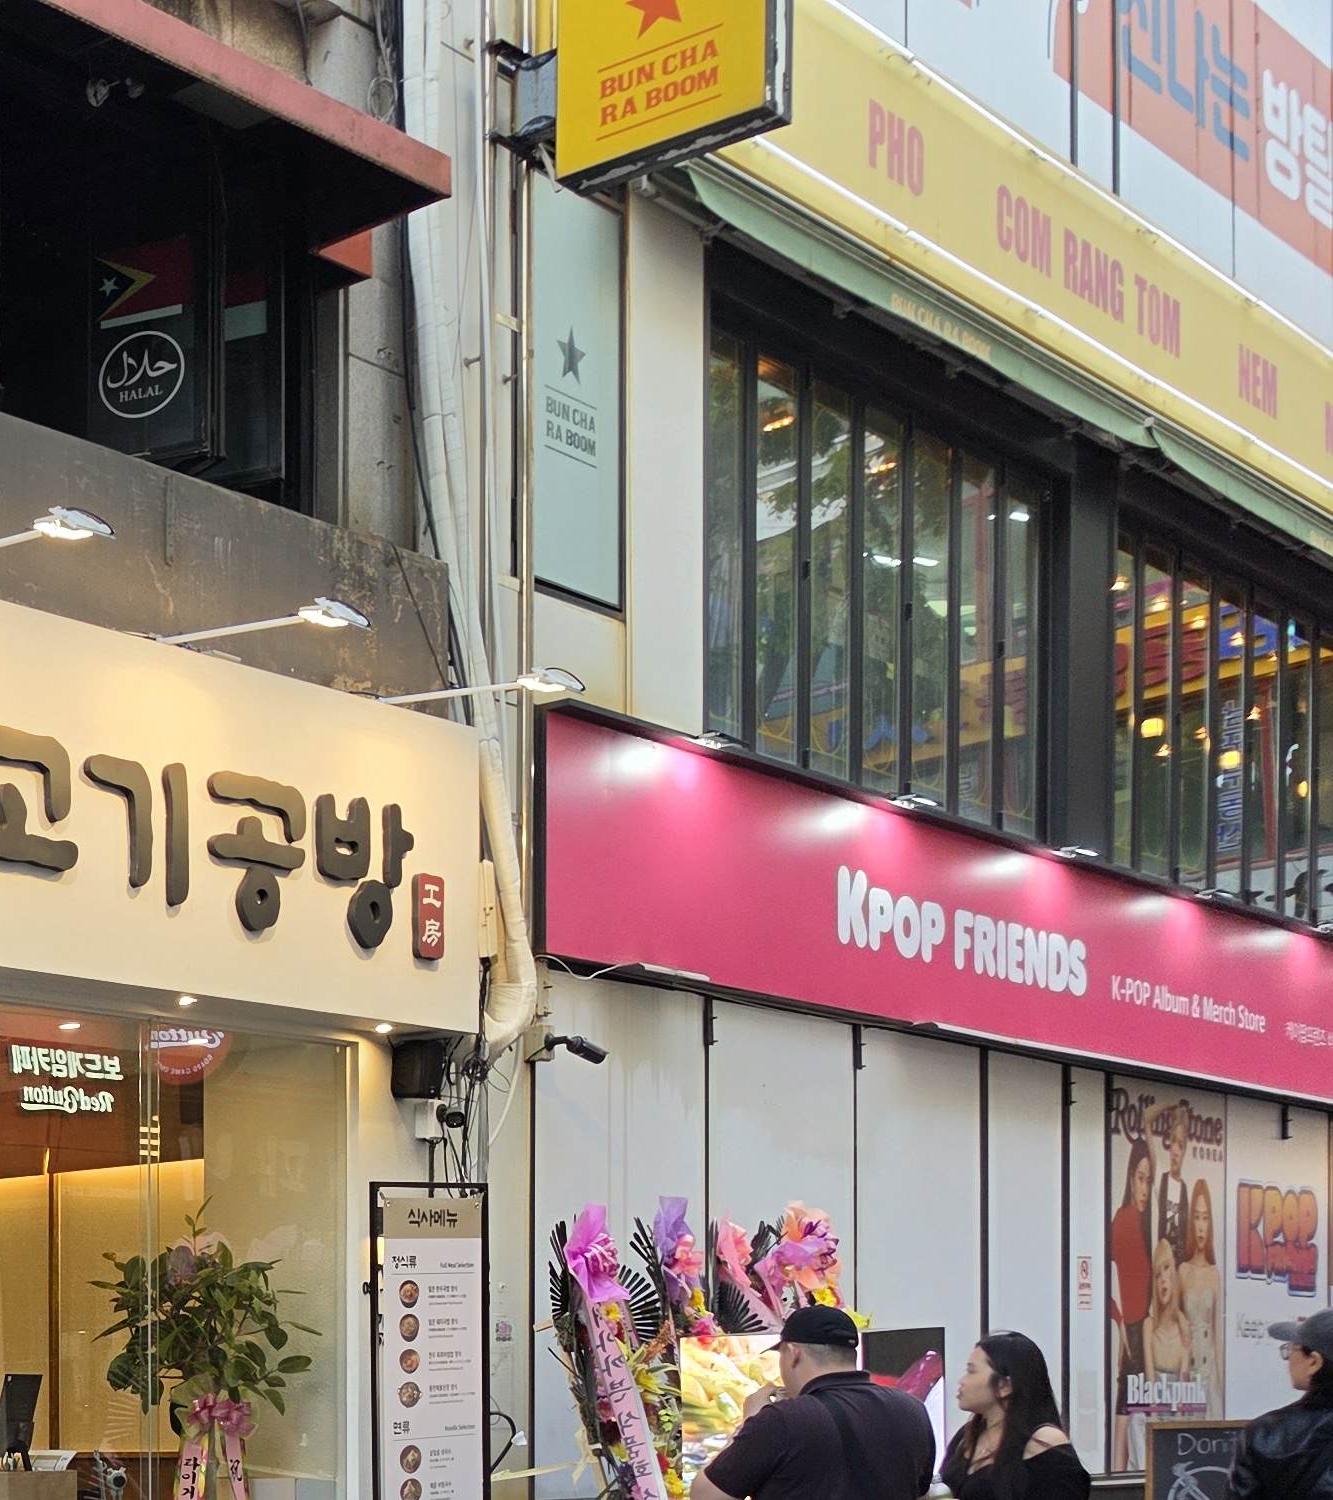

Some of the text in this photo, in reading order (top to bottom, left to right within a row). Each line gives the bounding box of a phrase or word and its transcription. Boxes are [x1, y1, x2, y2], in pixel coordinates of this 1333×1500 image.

[599, 38, 721, 101] BUN CHA
[599, 64, 721, 128] RA BOOM
[868, 99, 925, 198] PHO
[995, 184, 1182, 359] COM RANG TOM
[106, 348, 178, 389] حلال
[119, 384, 164, 403] HALAL
[1238, 342, 1278, 420] NEM
[545, 395, 597, 433] BUN CHA
[545, 420, 597, 457] RA BOOM
[420, 883, 443, 947] 工房
[836, 863, 1088, 998] KPOP FRIENDS
[1112, 975, 1267, 1033] K-POP Album & Merch Store
[407, 1207, 459, 1229] 식사메뉴
[1126, 1373, 1207, 1412] Blackpink
